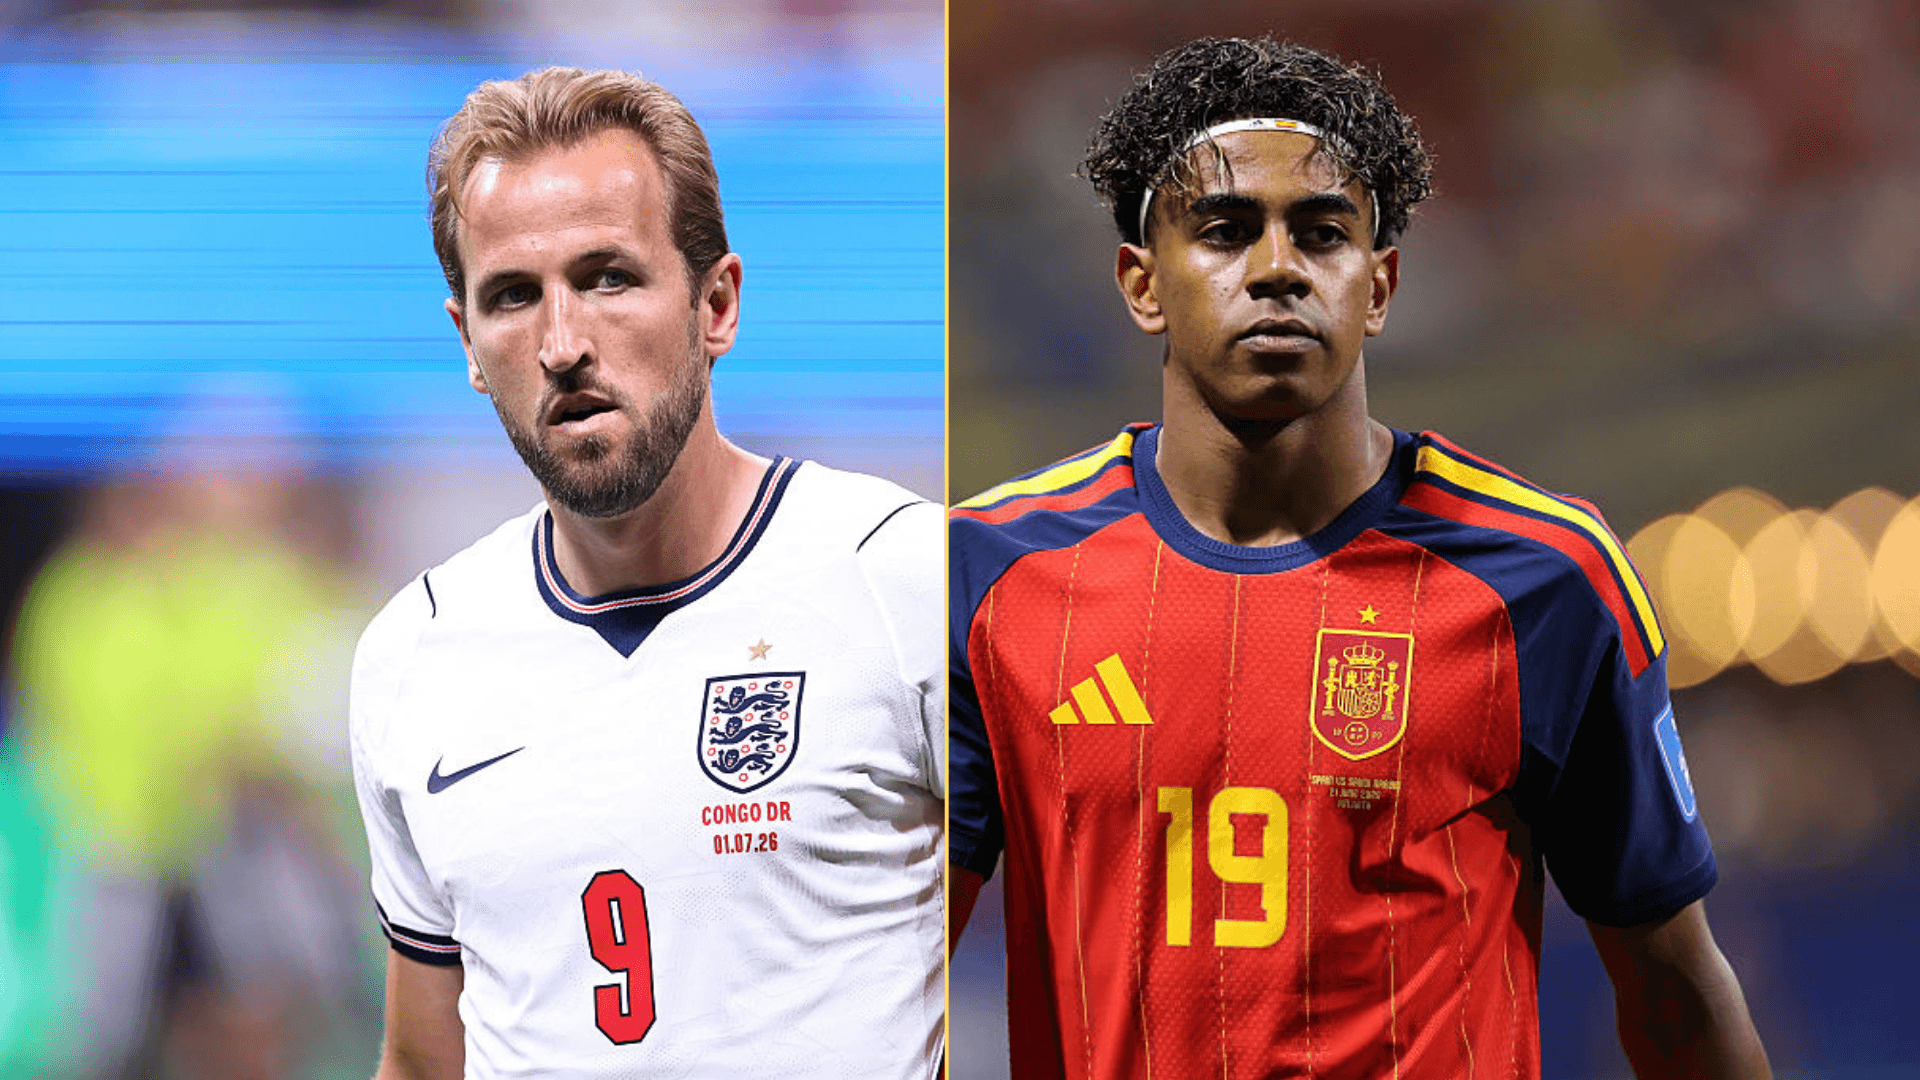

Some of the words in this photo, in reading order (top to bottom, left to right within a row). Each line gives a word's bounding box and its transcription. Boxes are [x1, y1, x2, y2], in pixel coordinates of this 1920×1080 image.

[702, 802, 761, 825] CONGO
[767, 801, 791, 822] DR
[713, 832, 778, 854] 01.07.26
[1157, 786, 1289, 948] 19
[581, 868, 657, 1046] 9
